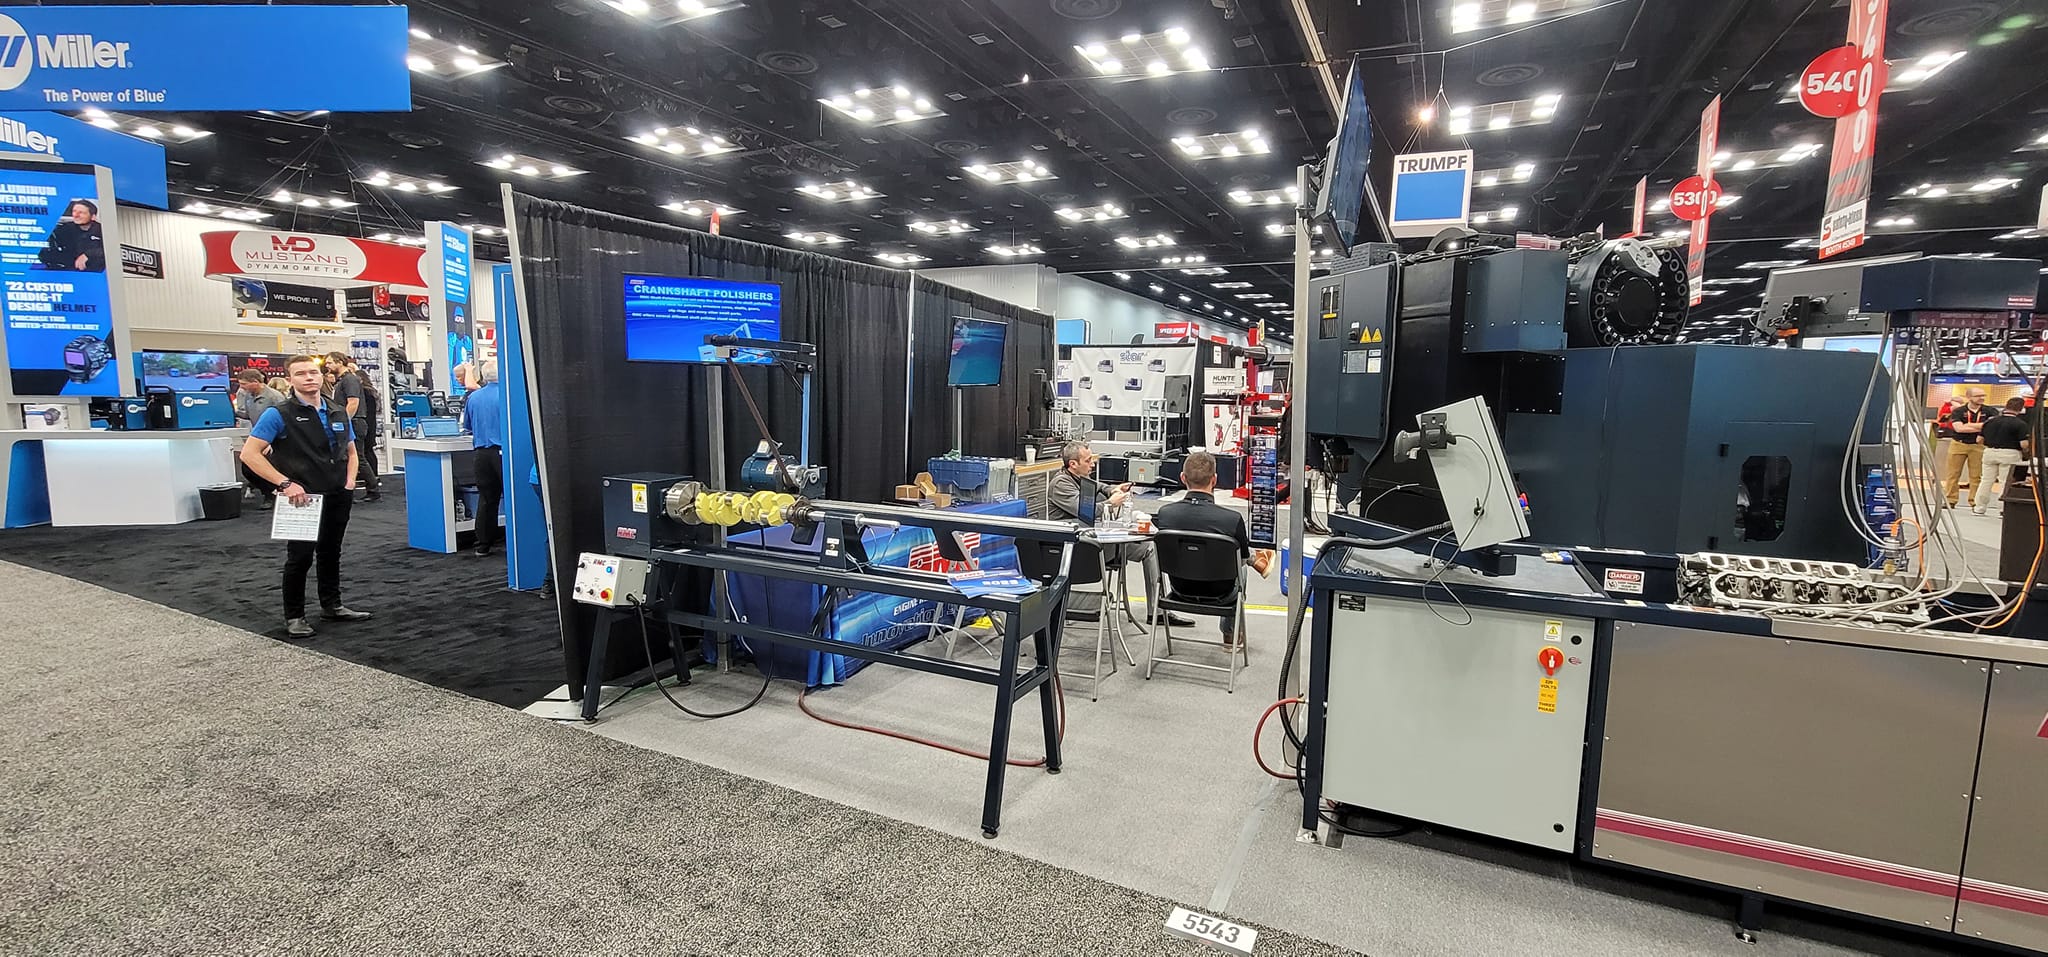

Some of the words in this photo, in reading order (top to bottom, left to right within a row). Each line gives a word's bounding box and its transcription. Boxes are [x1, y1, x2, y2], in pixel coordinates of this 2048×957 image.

[36, 35, 130, 69] Miller
[1807, 70, 1857, 95] 540
[43, 89, 68, 102] The
[73, 89, 113, 102] Power
[117, 89, 130, 102] of
[134, 89, 166, 103] Blue
[1399, 155, 1467, 172] TRUMPF
[0, 184, 57, 196] LUMINUM
[121, 249, 154, 265] ENTROID
[246, 252, 348, 265] MUSTANG
[247, 263, 349, 275] DYNAMOMETER
[25, 282, 74, 294] CUSTOM
[634, 285, 709, 297] CRANKSHAFT
[713, 289, 774, 301] POLISHERS
[273, 293, 286, 301] WE
[286, 295, 310, 304] PROVE
[8, 302, 52, 312] DESIGN
[54, 303, 97, 313] HELMET
[247, 358, 269, 367] MD
[1213, 375, 1236, 383] HUNTE
[1608, 572, 1641, 582] DANGER
[893, 598, 918, 616] ENGINE
[1183, 913, 1240, 944] 5543
